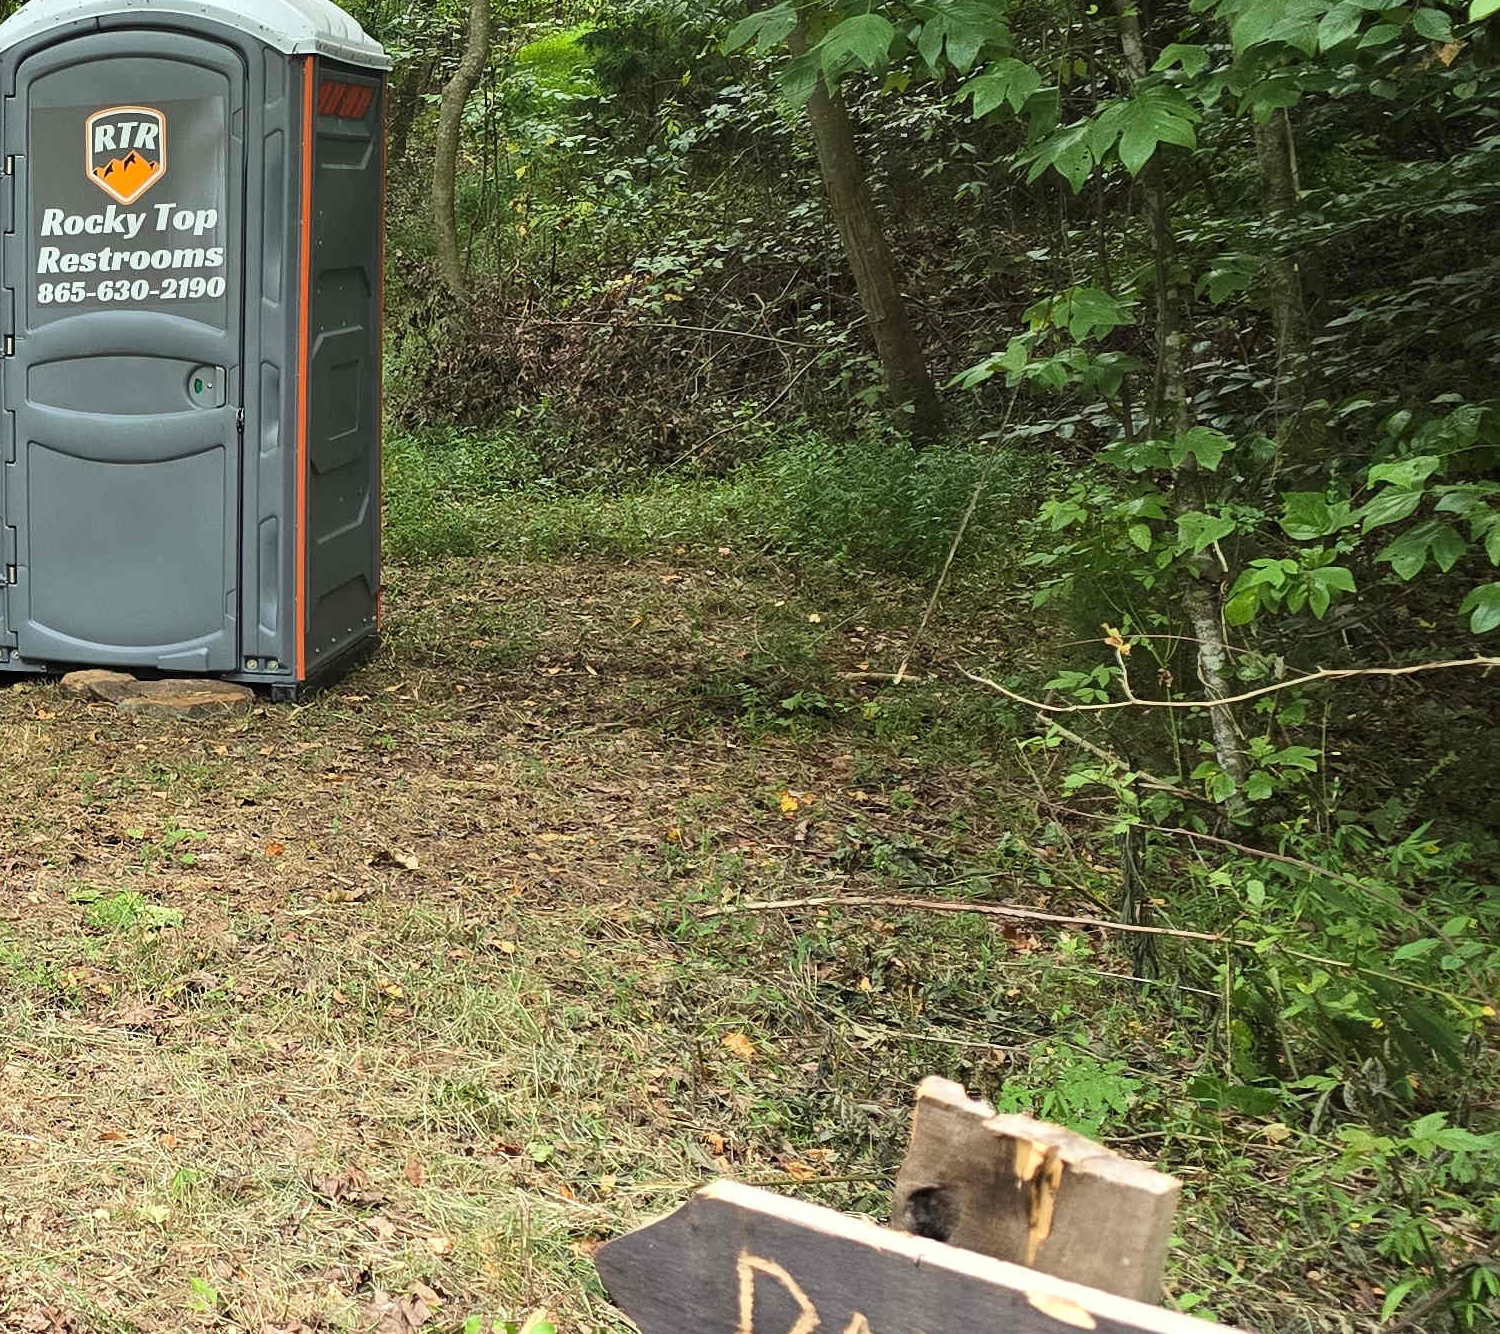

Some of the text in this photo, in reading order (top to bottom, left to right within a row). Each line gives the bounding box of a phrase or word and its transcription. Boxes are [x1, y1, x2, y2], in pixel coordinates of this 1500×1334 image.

[94, 121, 159, 153] RTR
[40, 202, 218, 239] Rocky Top
[37, 246, 224, 274] Restrooms
[37, 276, 226, 304] 865-630-2190
